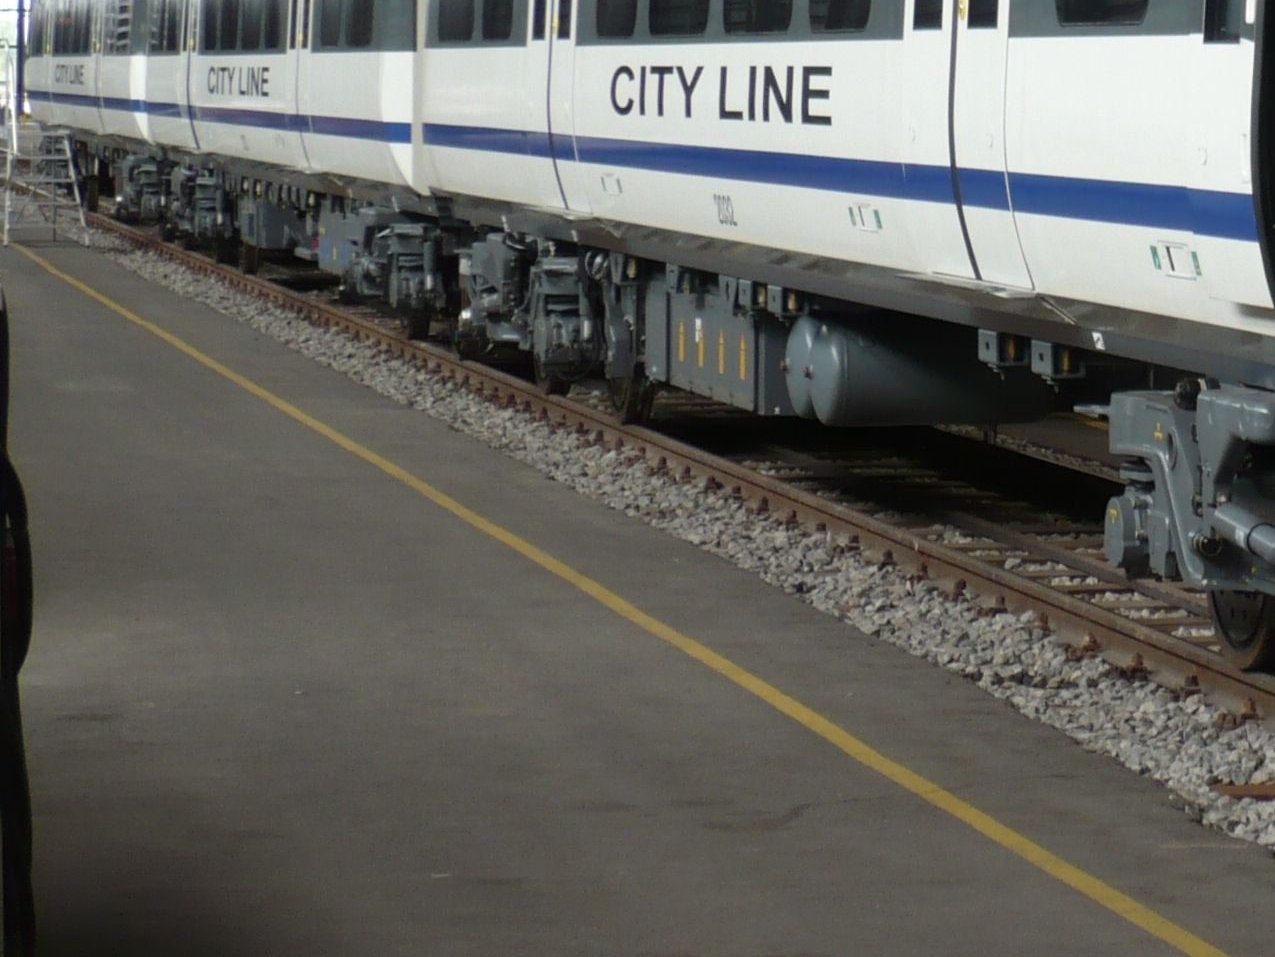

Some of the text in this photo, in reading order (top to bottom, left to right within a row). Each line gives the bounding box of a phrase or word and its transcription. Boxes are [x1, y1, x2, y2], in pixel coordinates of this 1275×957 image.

[207, 66, 270, 97] CITY LINE
[610, 65, 833, 127] CITY LINE
